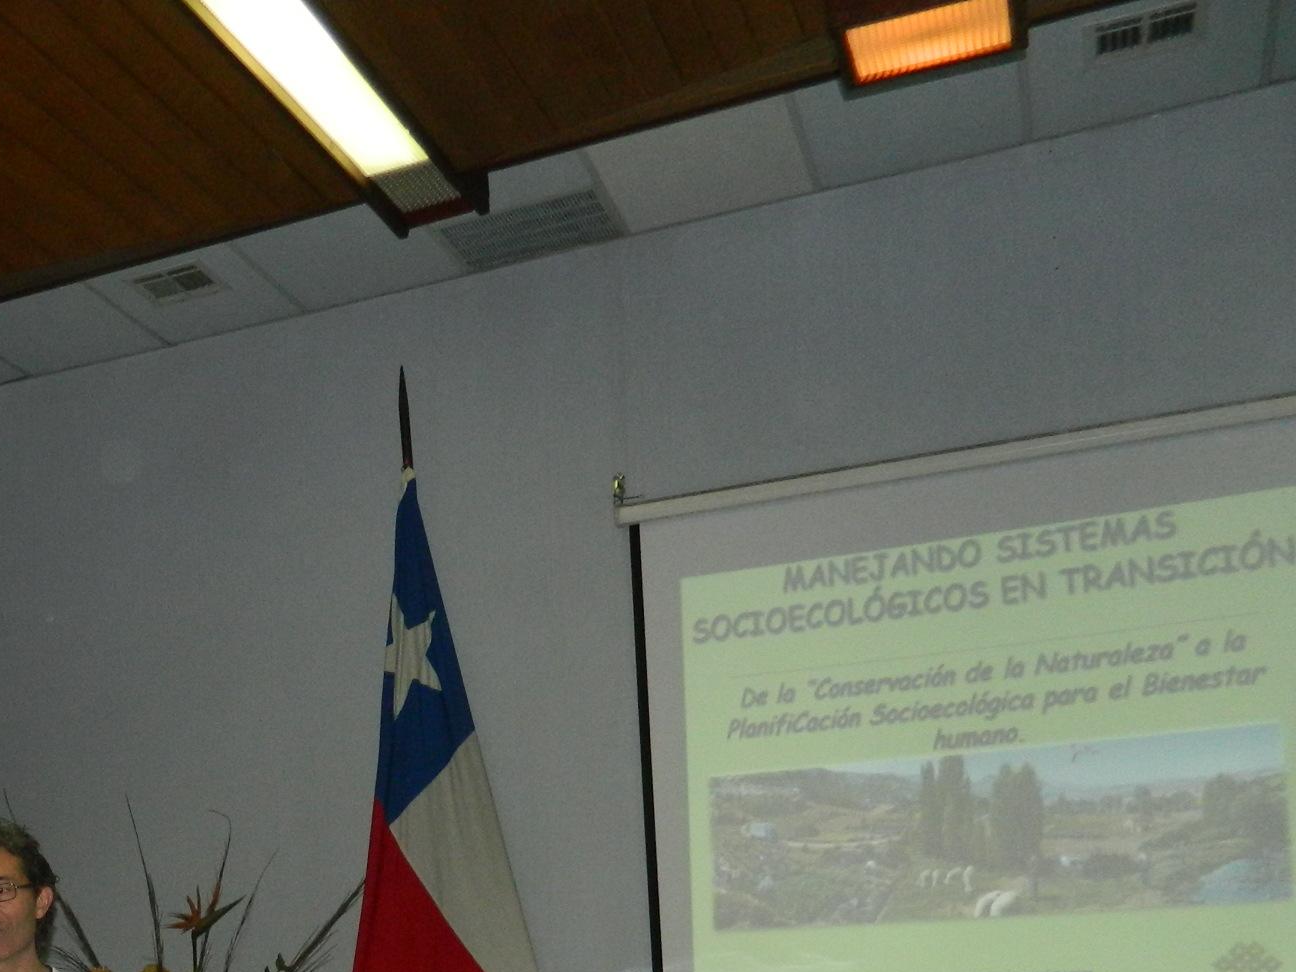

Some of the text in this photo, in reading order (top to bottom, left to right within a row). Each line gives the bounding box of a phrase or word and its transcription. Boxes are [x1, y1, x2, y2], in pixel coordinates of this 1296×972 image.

[692, 528, 1296, 645] SOCIOECOLÓGICOS EN TRANSICIÓN
[783, 509, 1177, 594] MANEJANDO SISTEMAS
[740, 686, 769, 709] De
[776, 682, 796, 704] la
[965, 659, 994, 683] de
[1004, 656, 1025, 680] la
[1195, 638, 1212, 657] a
[1223, 627, 1248, 653] la
[869, 689, 1035, 726] Socioecológica
[1042, 684, 1099, 715] para
[1108, 674, 1133, 699] el
[1141, 664, 1267, 697] Bienestar
[933, 726, 1025, 751] humano.
